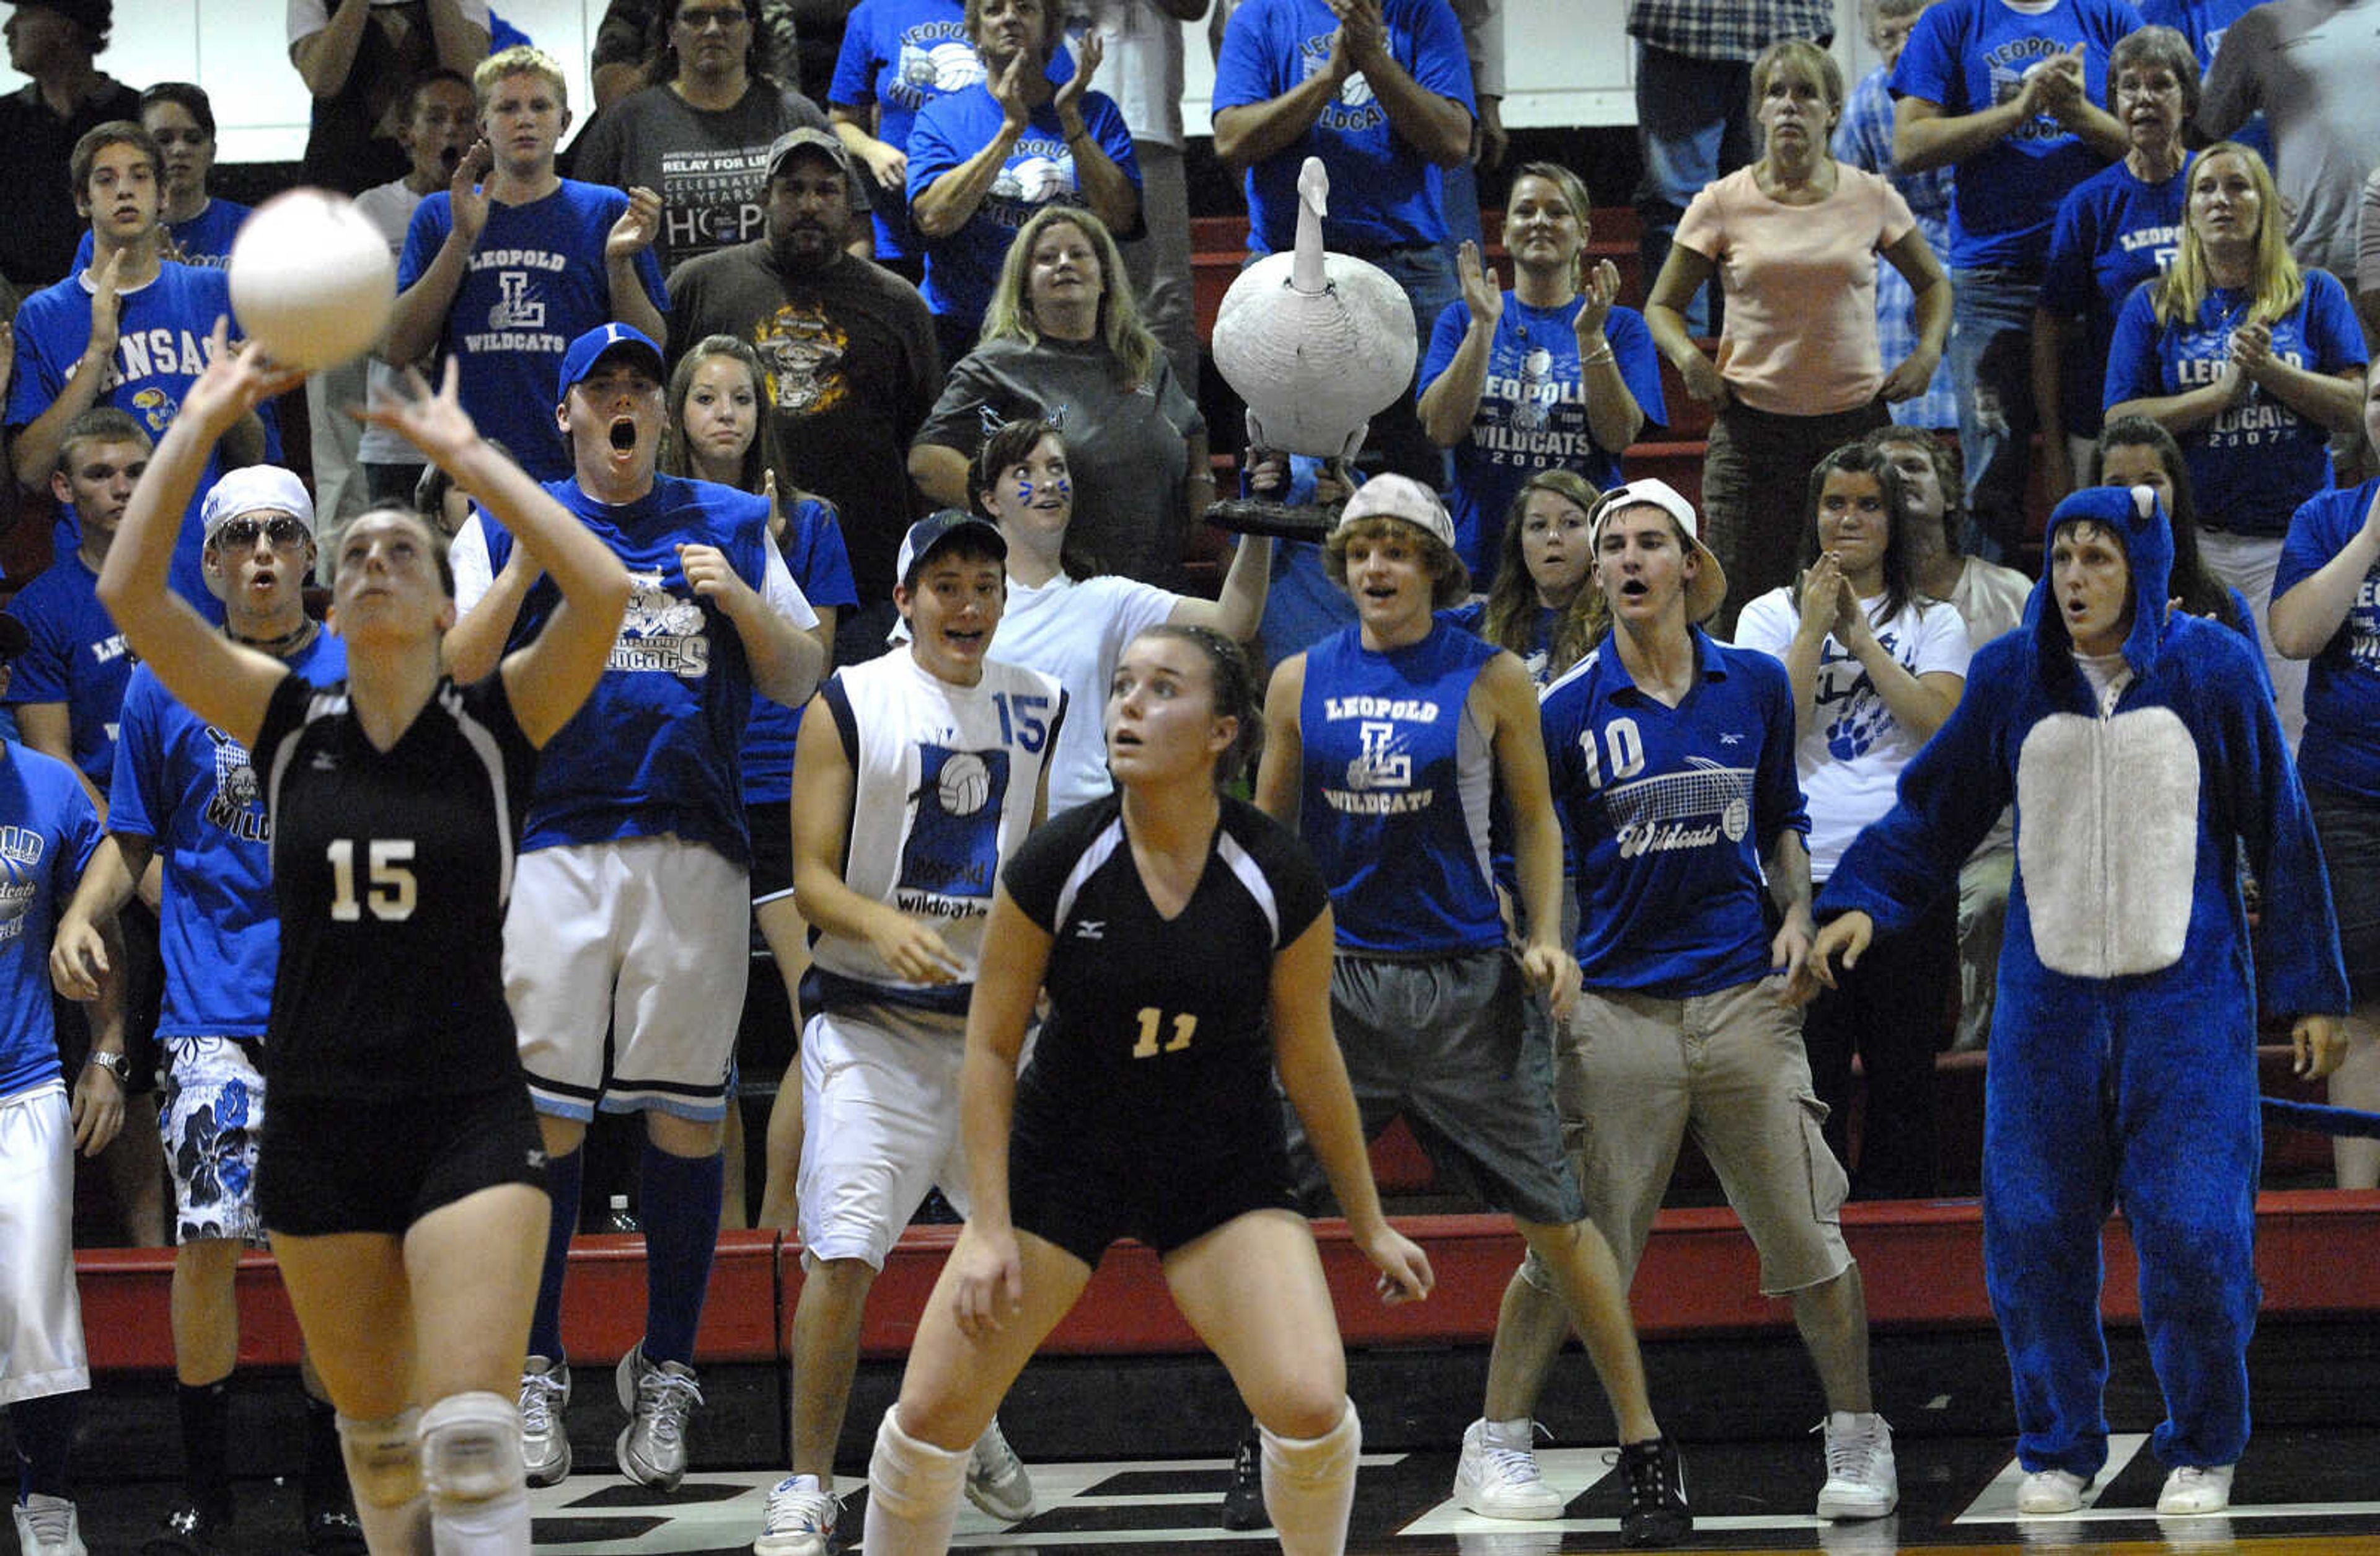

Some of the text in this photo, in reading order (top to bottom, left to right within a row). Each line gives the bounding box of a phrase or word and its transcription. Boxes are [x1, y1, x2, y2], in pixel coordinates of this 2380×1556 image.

[1320, 105, 1383, 132] LDCA
[1011, 138, 1073, 159] POLD
[663, 154, 769, 174] RELAY FOR LIF
[665, 188, 755, 206] 25 YEARS
[666, 203, 764, 246] HOP
[2120, 225, 2186, 252] LEOPO
[469, 249, 566, 272] LEOPOLD
[465, 333, 565, 352] WILDCATS
[64, 329, 214, 394] ANSA
[1486, 374, 1585, 407] EOPOL
[1473, 425, 1591, 456] WILDCATS
[2208, 430, 2280, 448] 2007
[1492, 451, 1566, 469] 2007
[992, 691, 1048, 753] 15
[1324, 695, 1440, 724] LEOPOLD
[1579, 717, 1646, 789] 10
[205, 794, 271, 843] WILD
[1616, 820, 1723, 859] Wildcats
[327, 839, 418, 921] 15
[1132, 1007, 1199, 1059] 11
